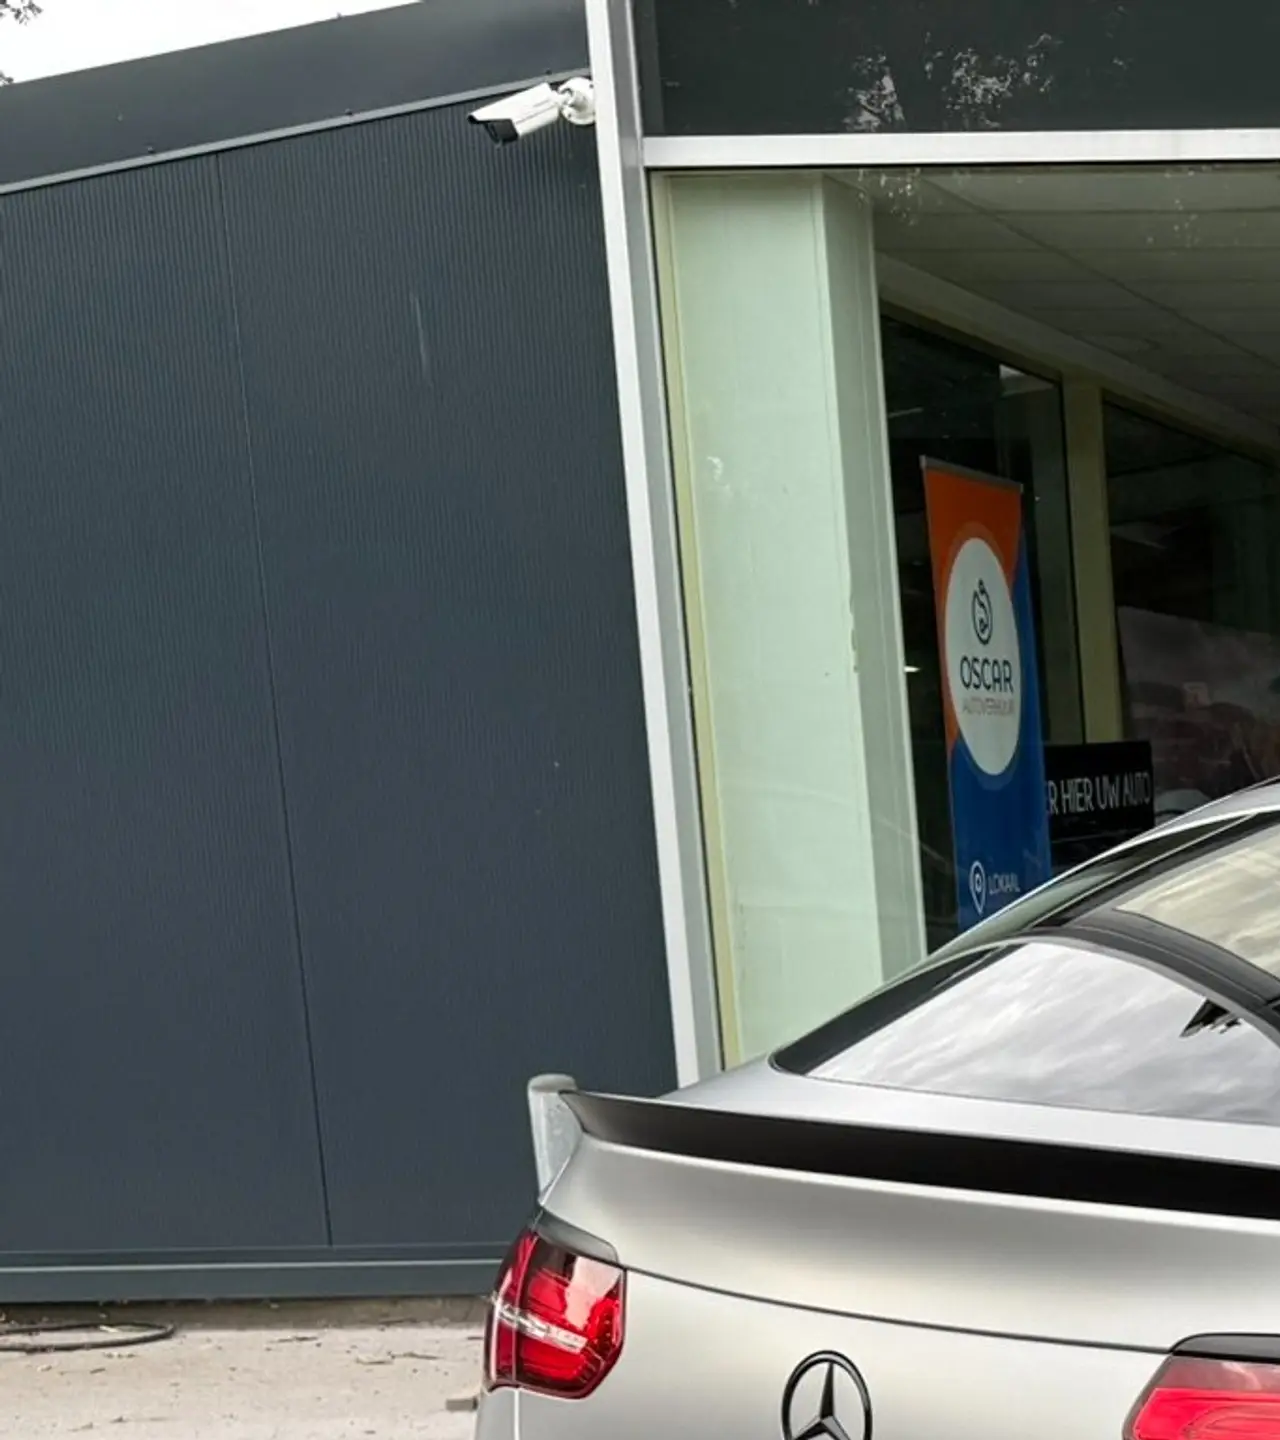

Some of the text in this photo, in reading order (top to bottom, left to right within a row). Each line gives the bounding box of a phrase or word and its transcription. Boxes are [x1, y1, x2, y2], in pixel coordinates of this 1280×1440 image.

[960, 655, 1014, 694] OSCAR
[1060, 777, 1094, 814] HIER
[1095, 774, 1119, 810] UW
[1122, 771, 1151, 807] AUTO
